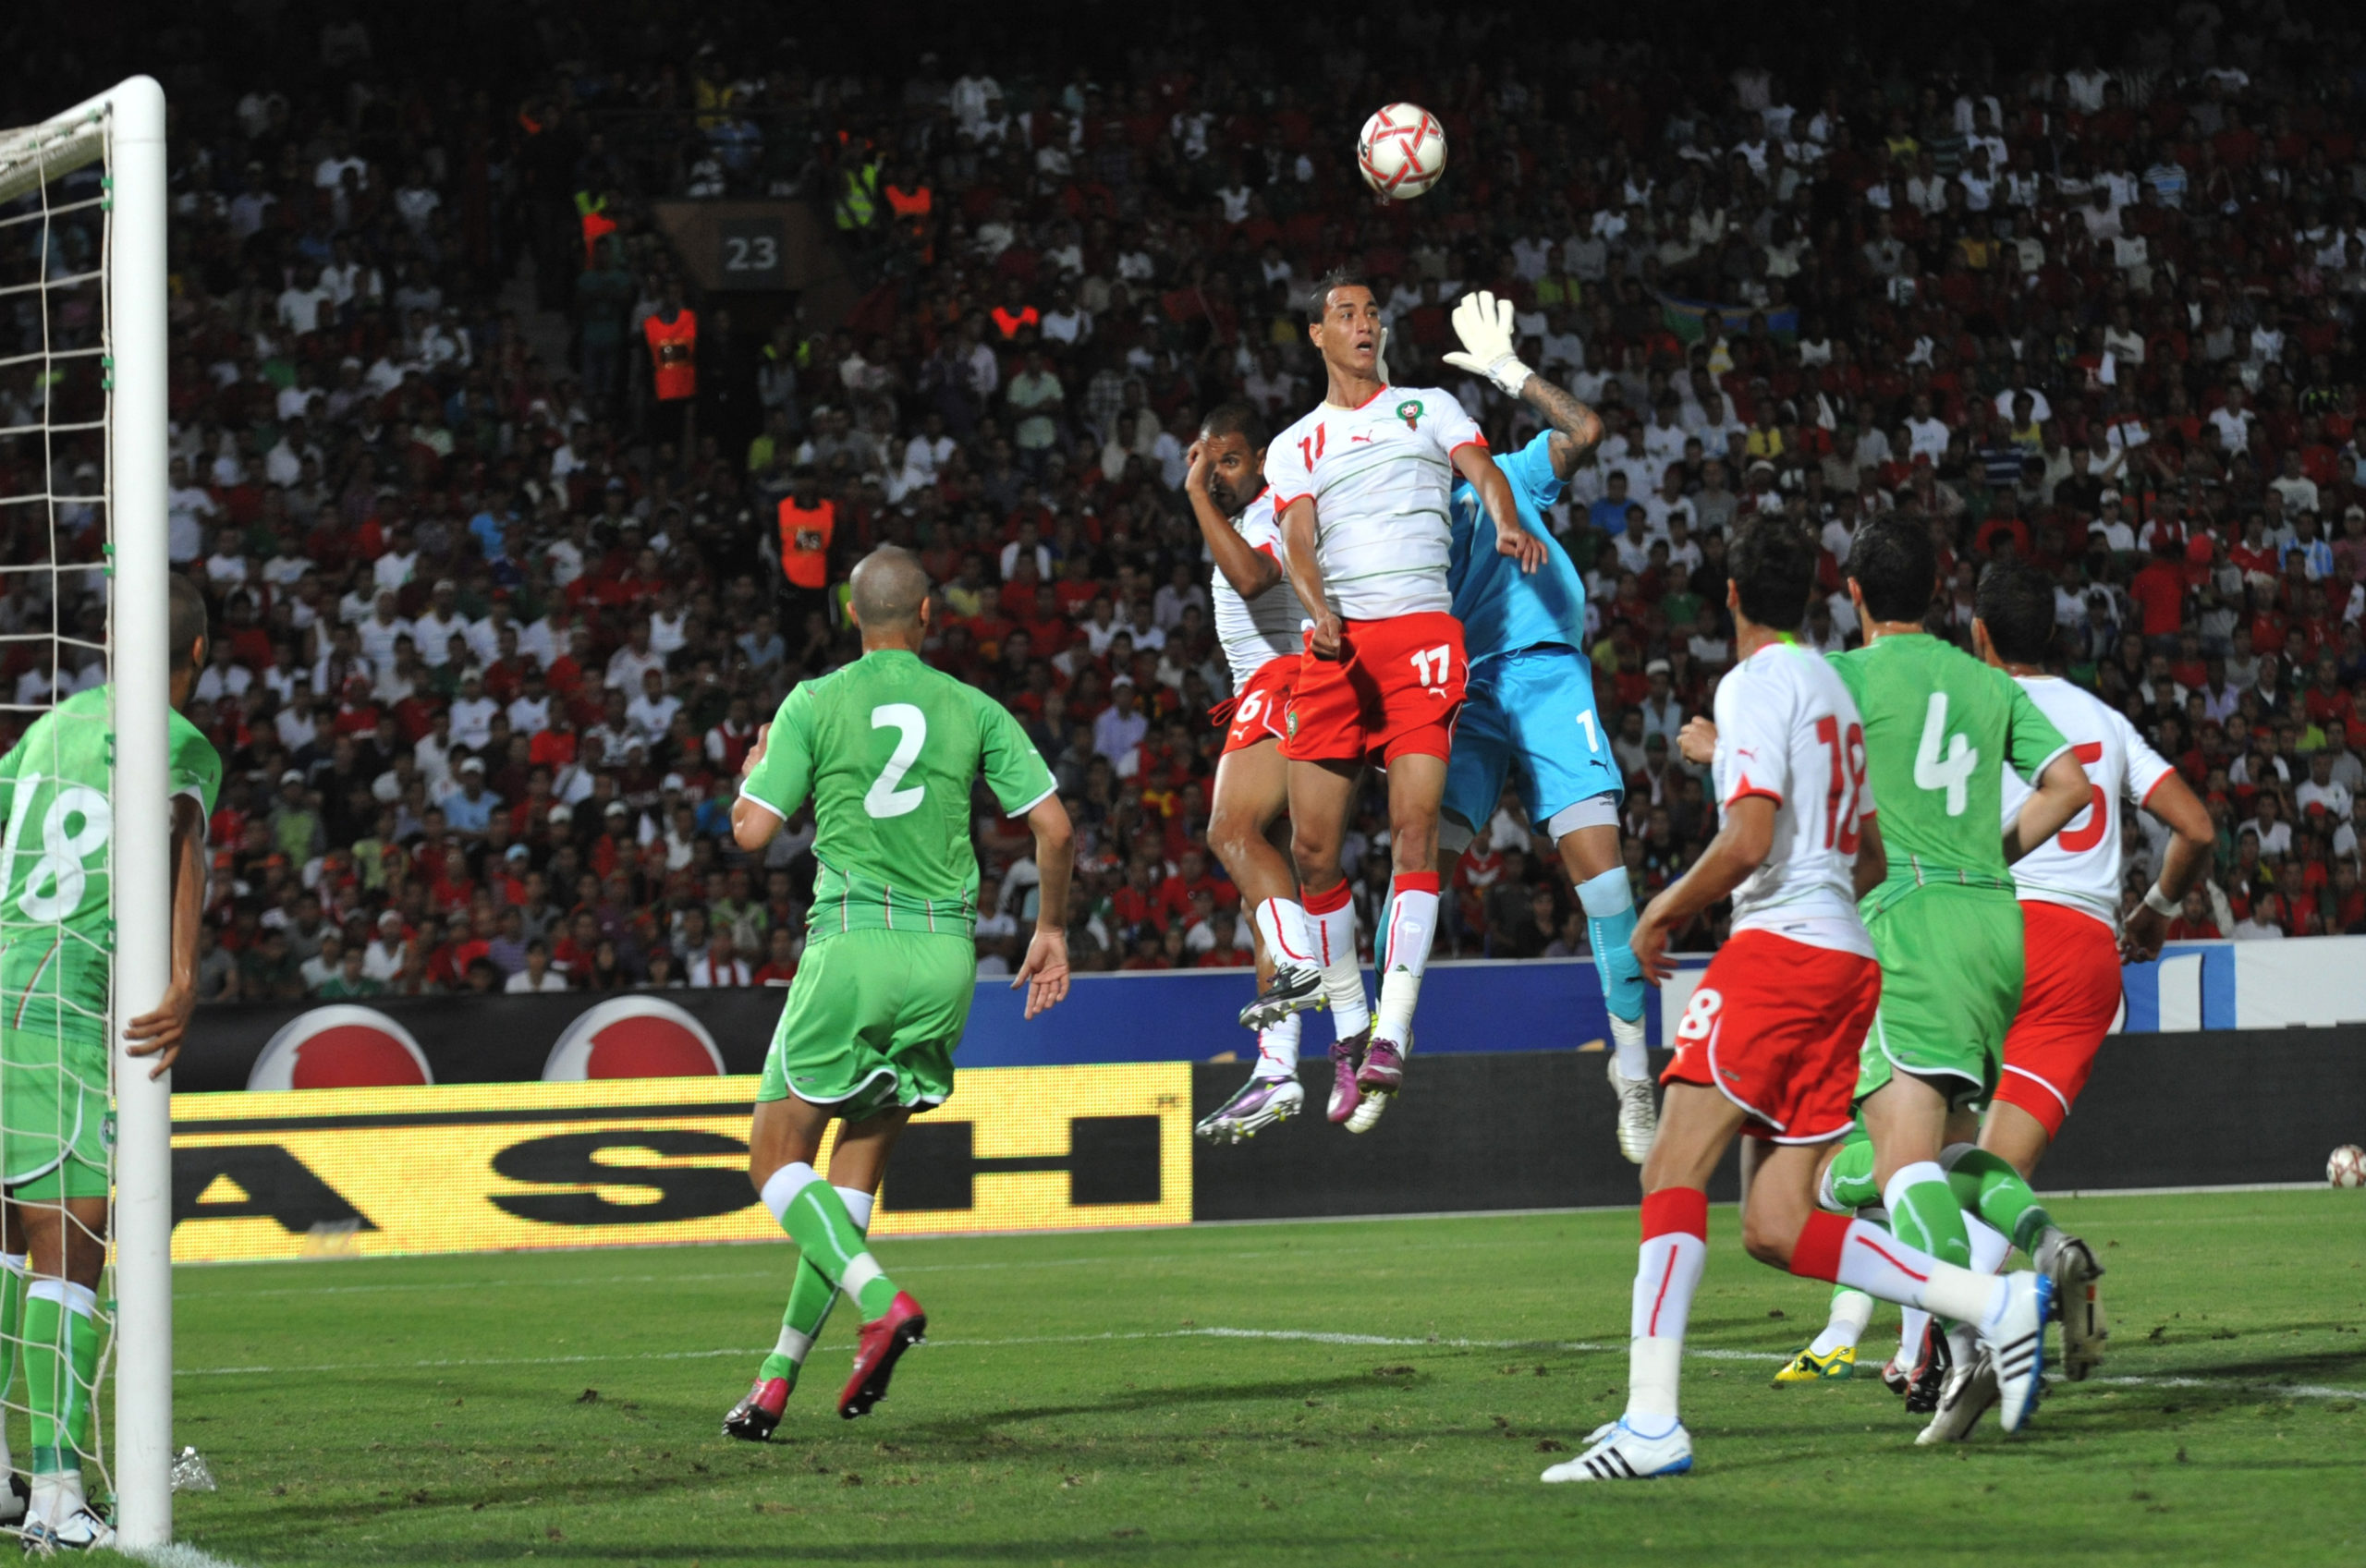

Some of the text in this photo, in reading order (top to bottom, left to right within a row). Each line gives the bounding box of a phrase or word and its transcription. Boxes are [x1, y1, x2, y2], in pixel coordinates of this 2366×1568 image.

[726, 237, 777, 270] 23
[1236, 688, 1265, 723] 6
[1410, 644, 1450, 687] 17
[863, 702, 927, 819] 2
[1576, 709, 1599, 753] 1
[1913, 692, 1978, 817] 4
[1816, 714, 1865, 856] 18
[0, 772, 112, 921] 18
